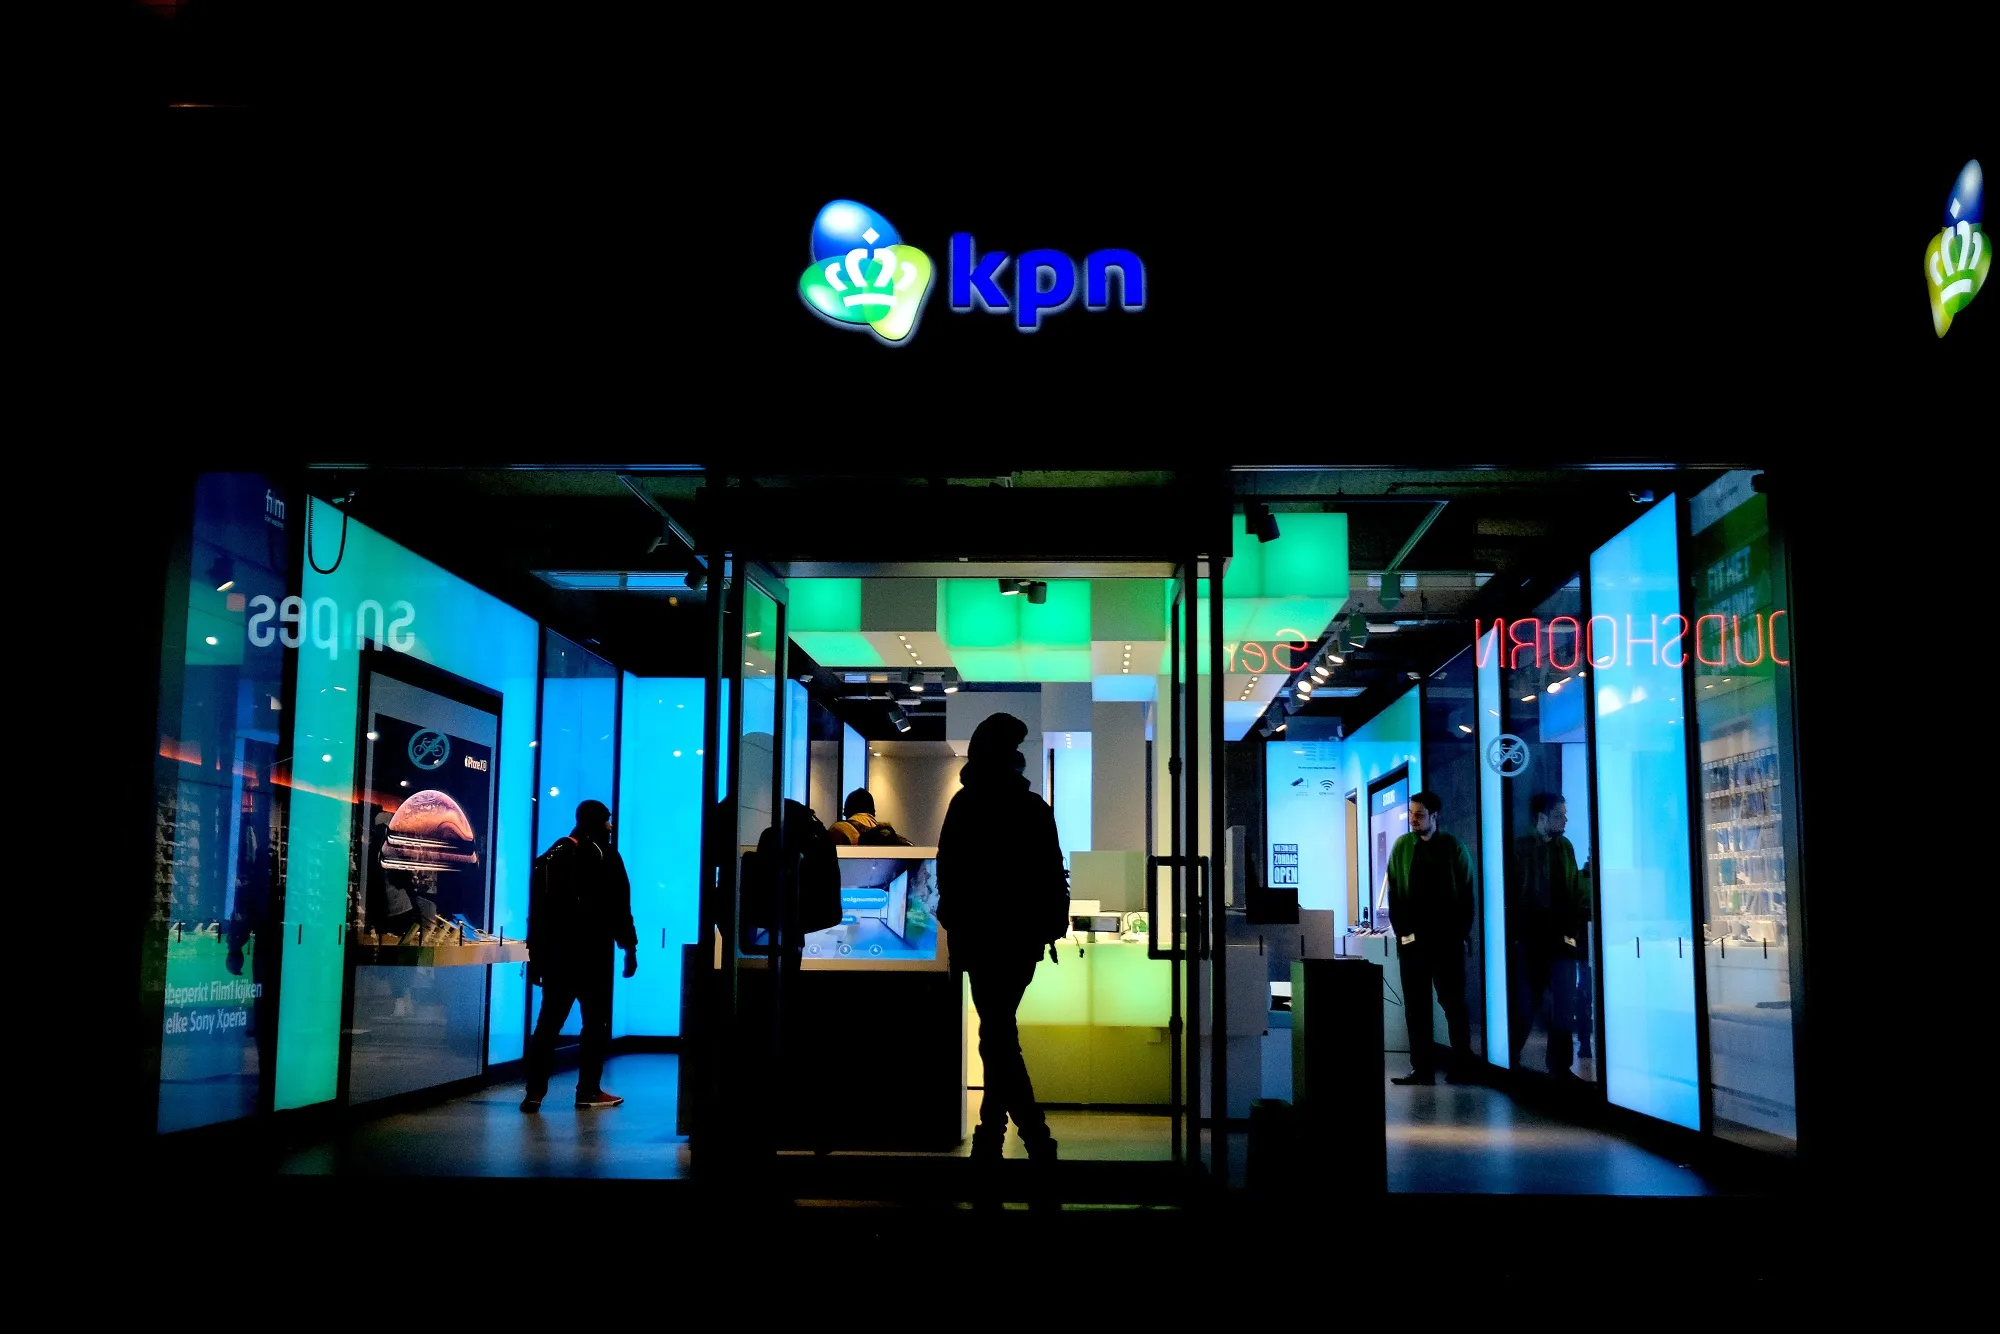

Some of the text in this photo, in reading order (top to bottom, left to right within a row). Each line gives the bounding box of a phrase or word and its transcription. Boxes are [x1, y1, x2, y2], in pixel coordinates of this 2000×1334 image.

[951, 231, 1144, 329] kpn
[1274, 854, 1298, 864] ZONDAG
[1274, 866, 1298, 883] OPEN
[235, 977, 262, 1004] kijken
[165, 1007, 247, 1035] elke Sony Xperia
